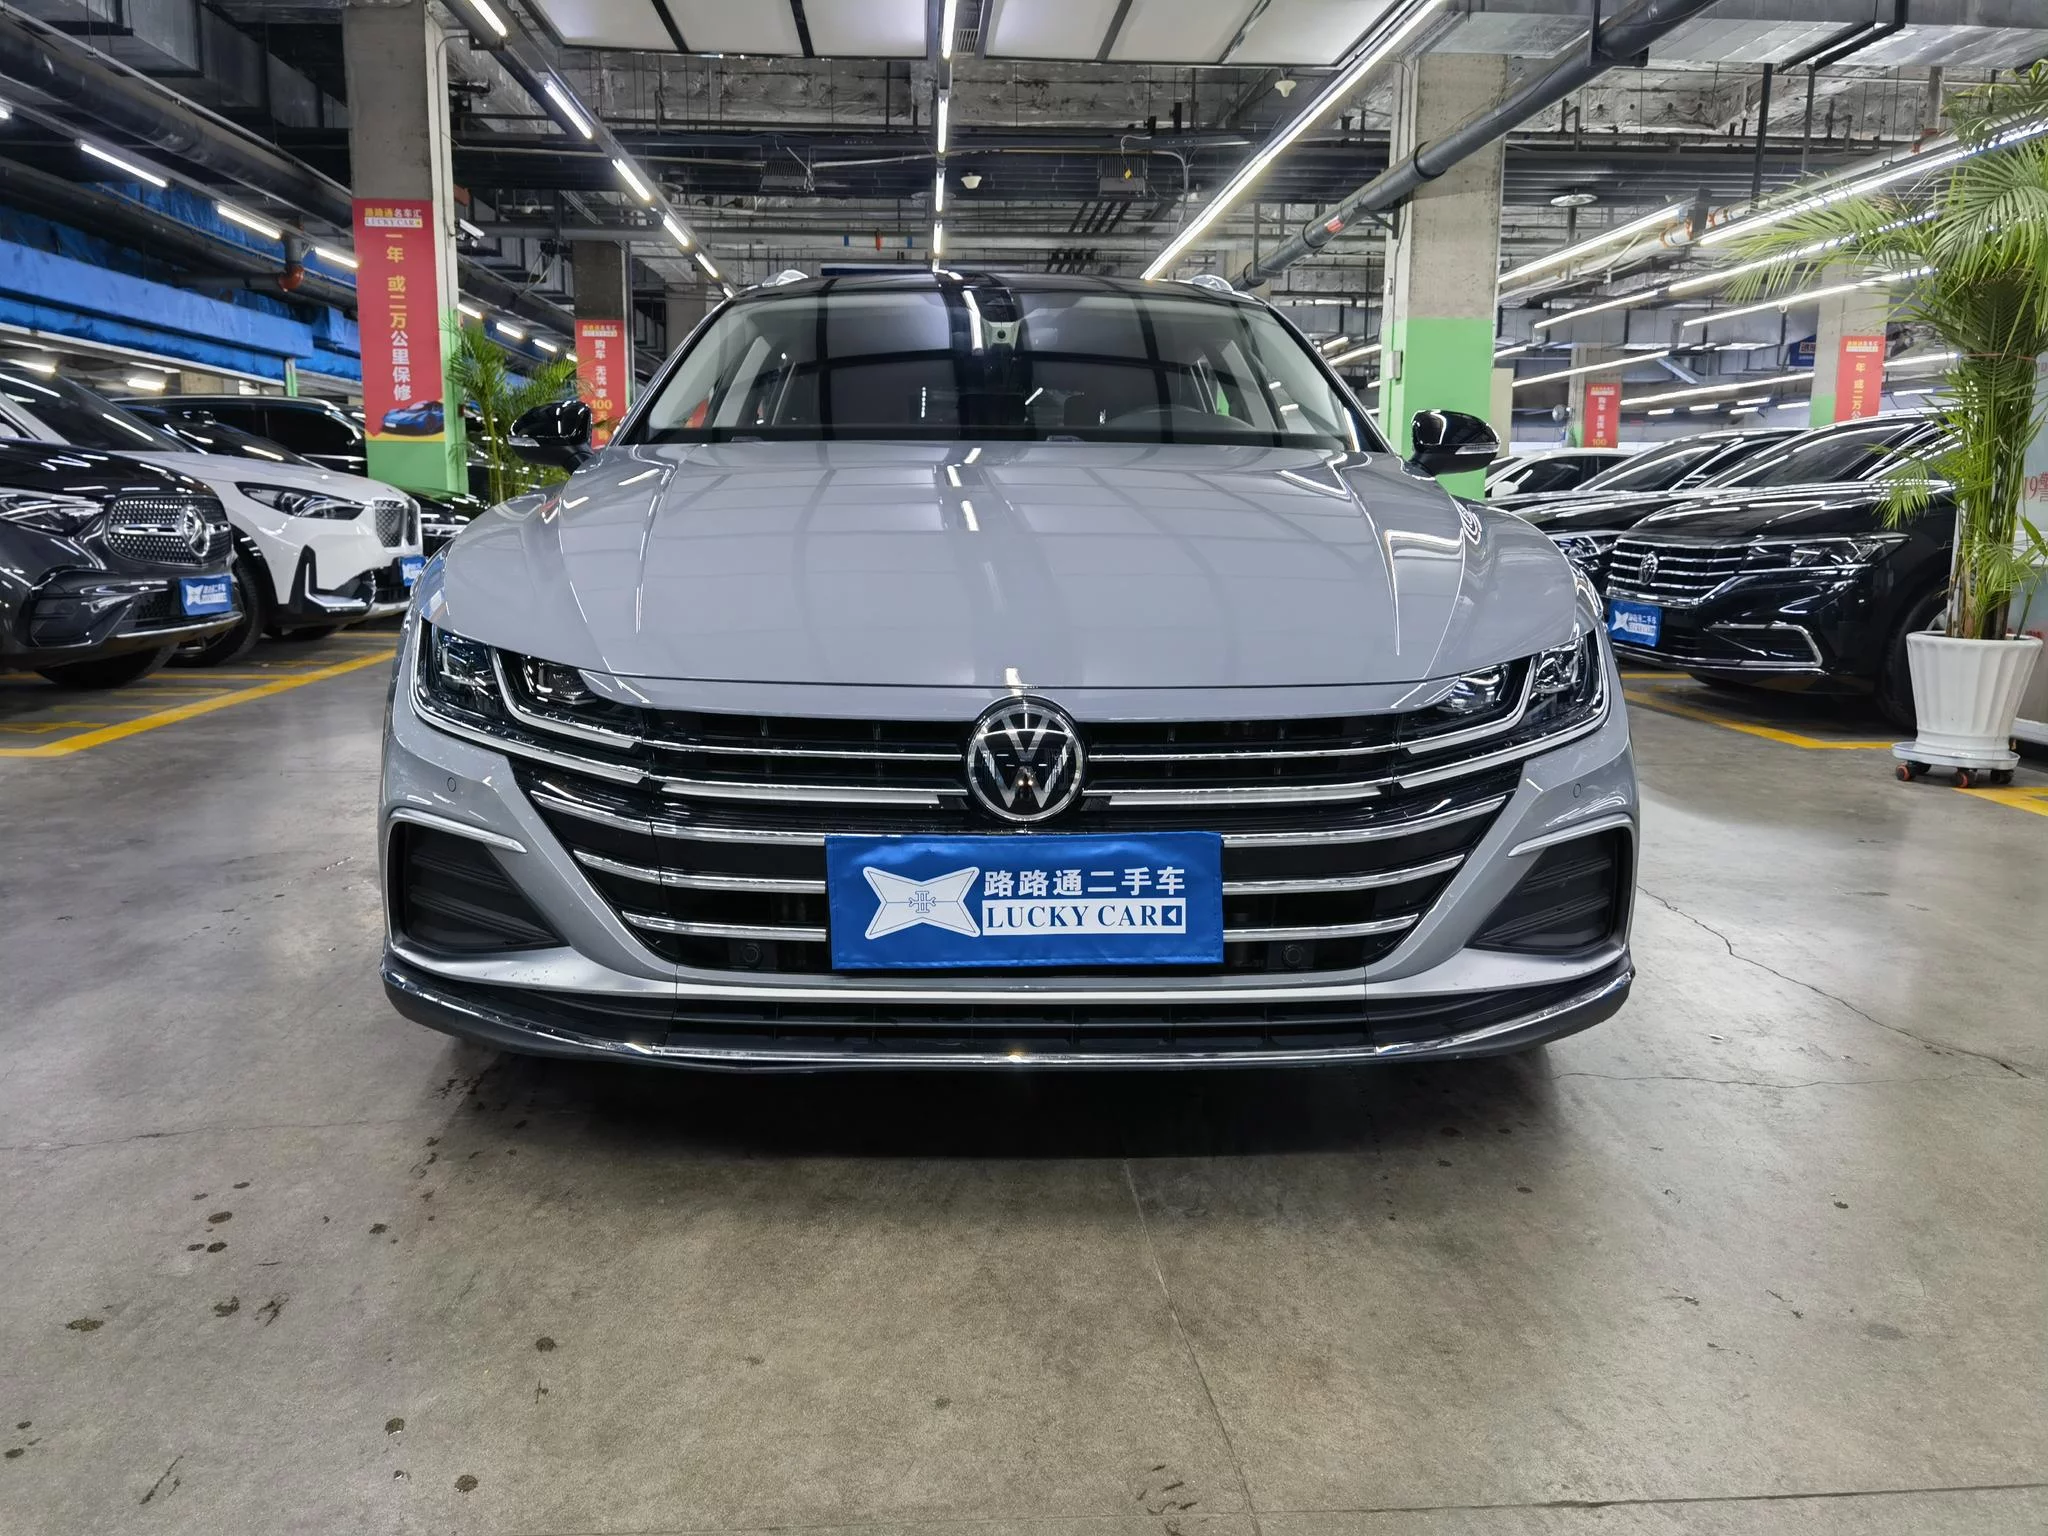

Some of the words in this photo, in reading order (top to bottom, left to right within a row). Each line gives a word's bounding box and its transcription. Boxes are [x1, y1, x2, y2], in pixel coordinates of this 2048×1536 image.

[983, 866, 1186, 898] 路路通二手车
[986, 905, 1089, 929] LUCKY
[1097, 904, 1159, 927] CAR
